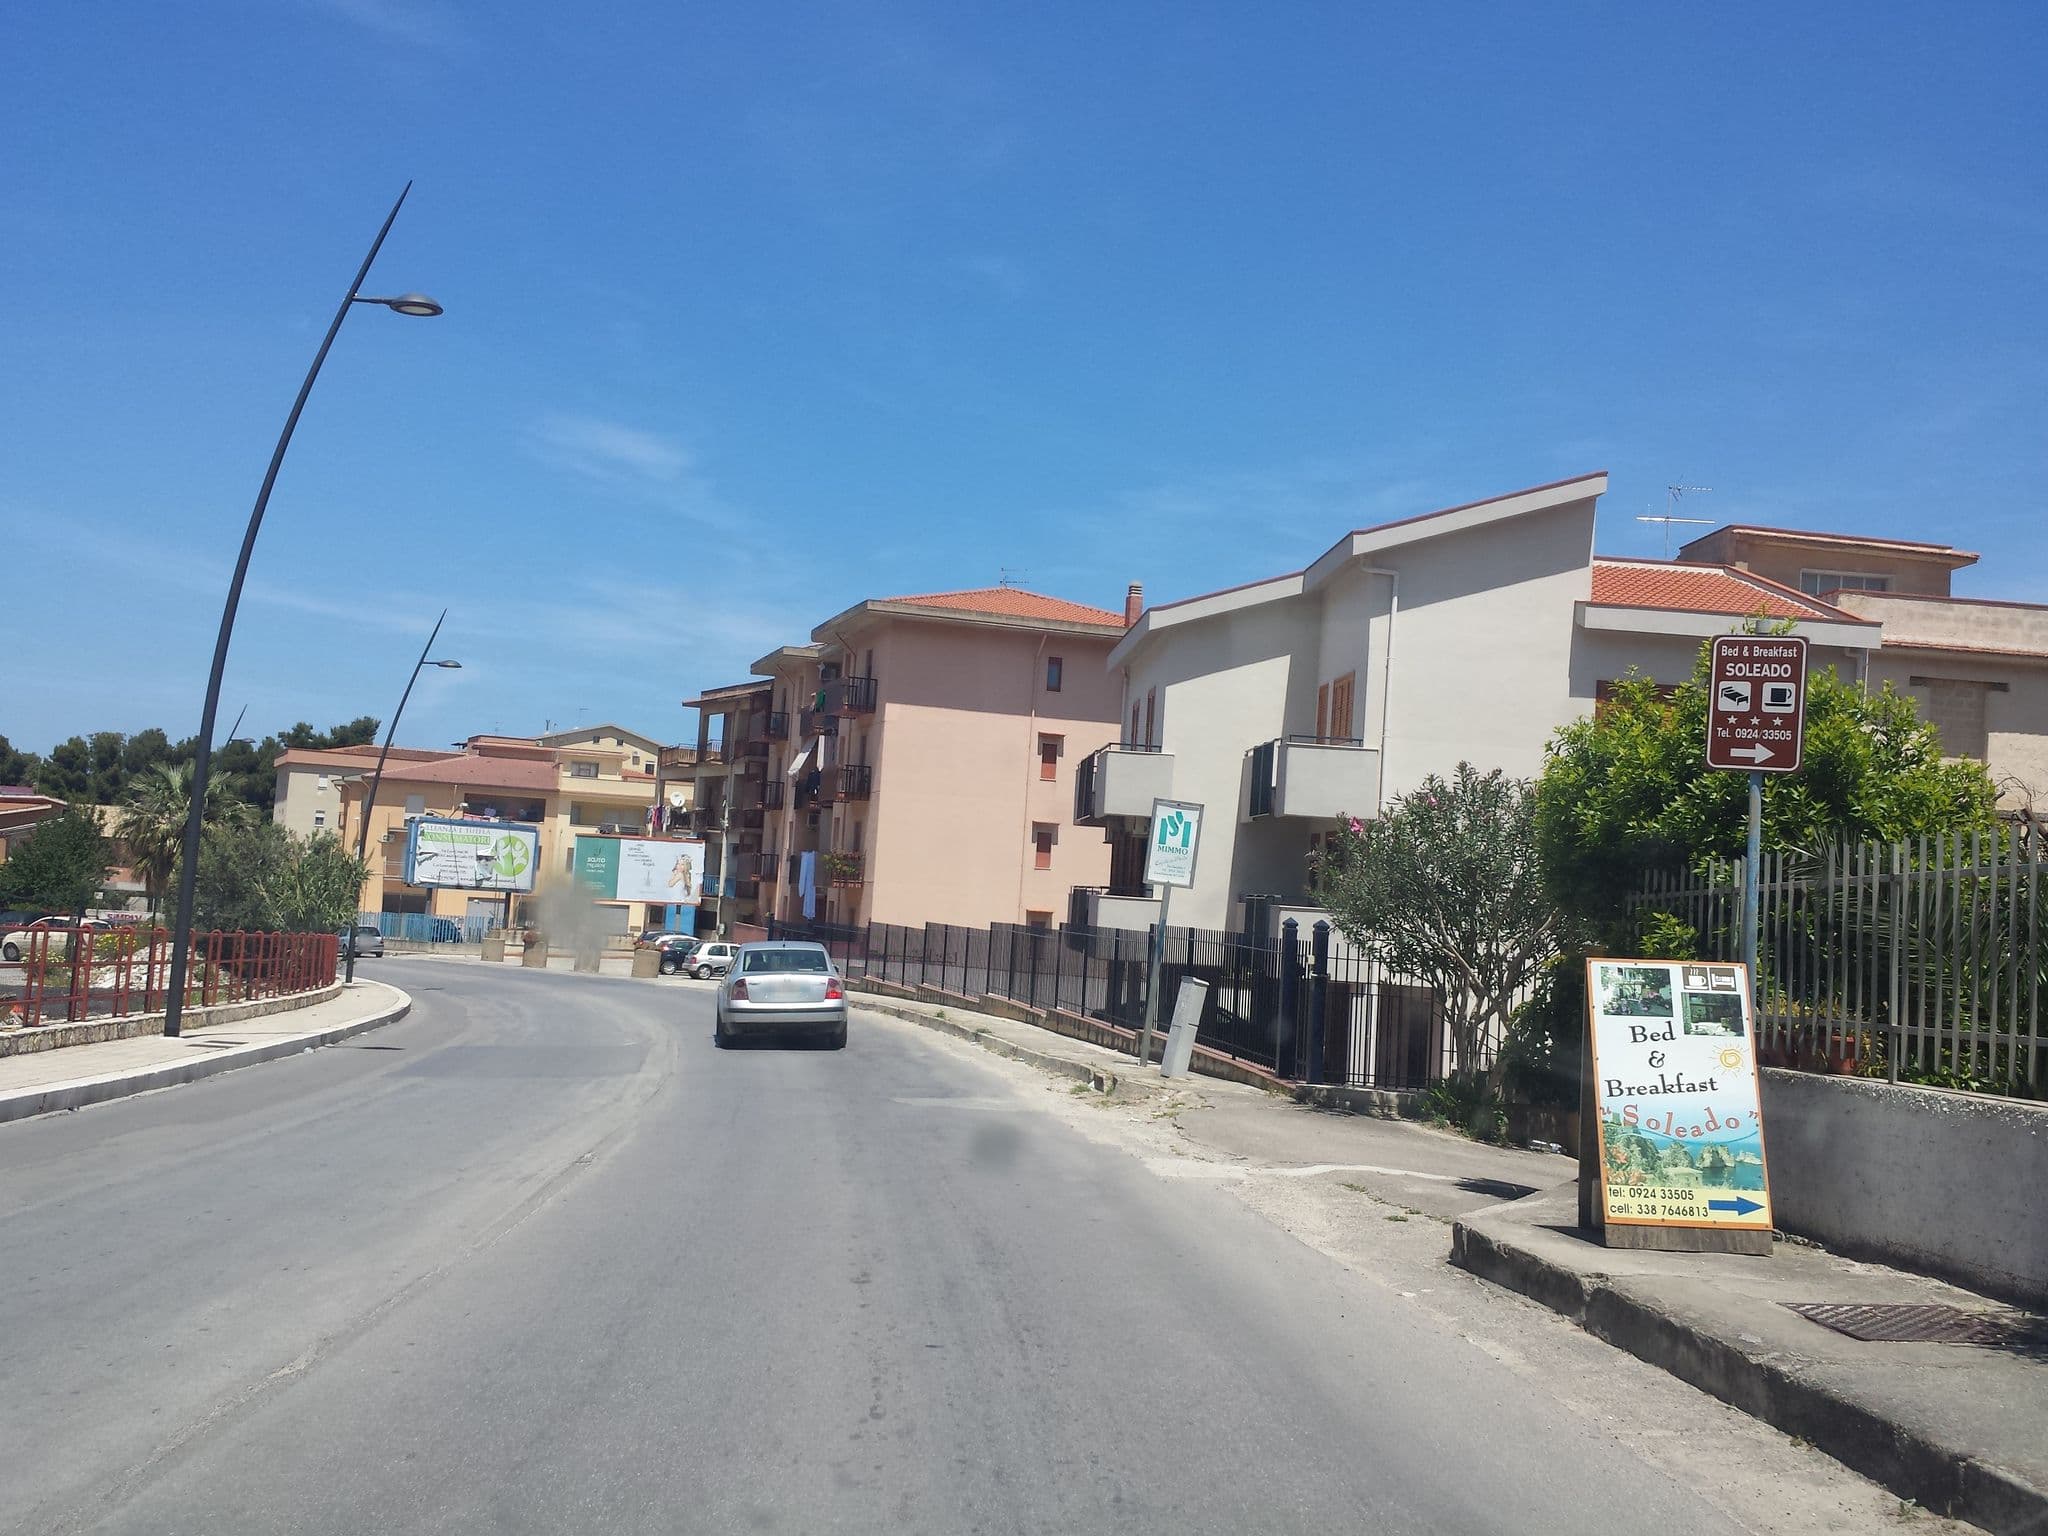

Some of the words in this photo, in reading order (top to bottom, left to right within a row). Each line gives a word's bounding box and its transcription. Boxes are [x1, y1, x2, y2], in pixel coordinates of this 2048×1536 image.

[1721, 645, 1739, 657] Bed
[1742, 646, 1749, 657] &
[1753, 646, 1798, 658] Breakfast
[1725, 663, 1792, 677] SOLEADO
[1157, 845, 1188, 856] MIMMO
[1628, 1021, 1676, 1043] Bed
[1648, 1051, 1666, 1068] &
[1604, 1073, 1719, 1098] Breakfast
[1608, 1187, 1625, 1198] tel:
[1629, 1188, 1656, 1199] 0924
[1660, 1189, 1694, 1200] 33505
[1610, 1203, 1633, 1214] cell:
[1637, 1204, 1657, 1215] 338
[1661, 1205, 1709, 1217] 7646813
